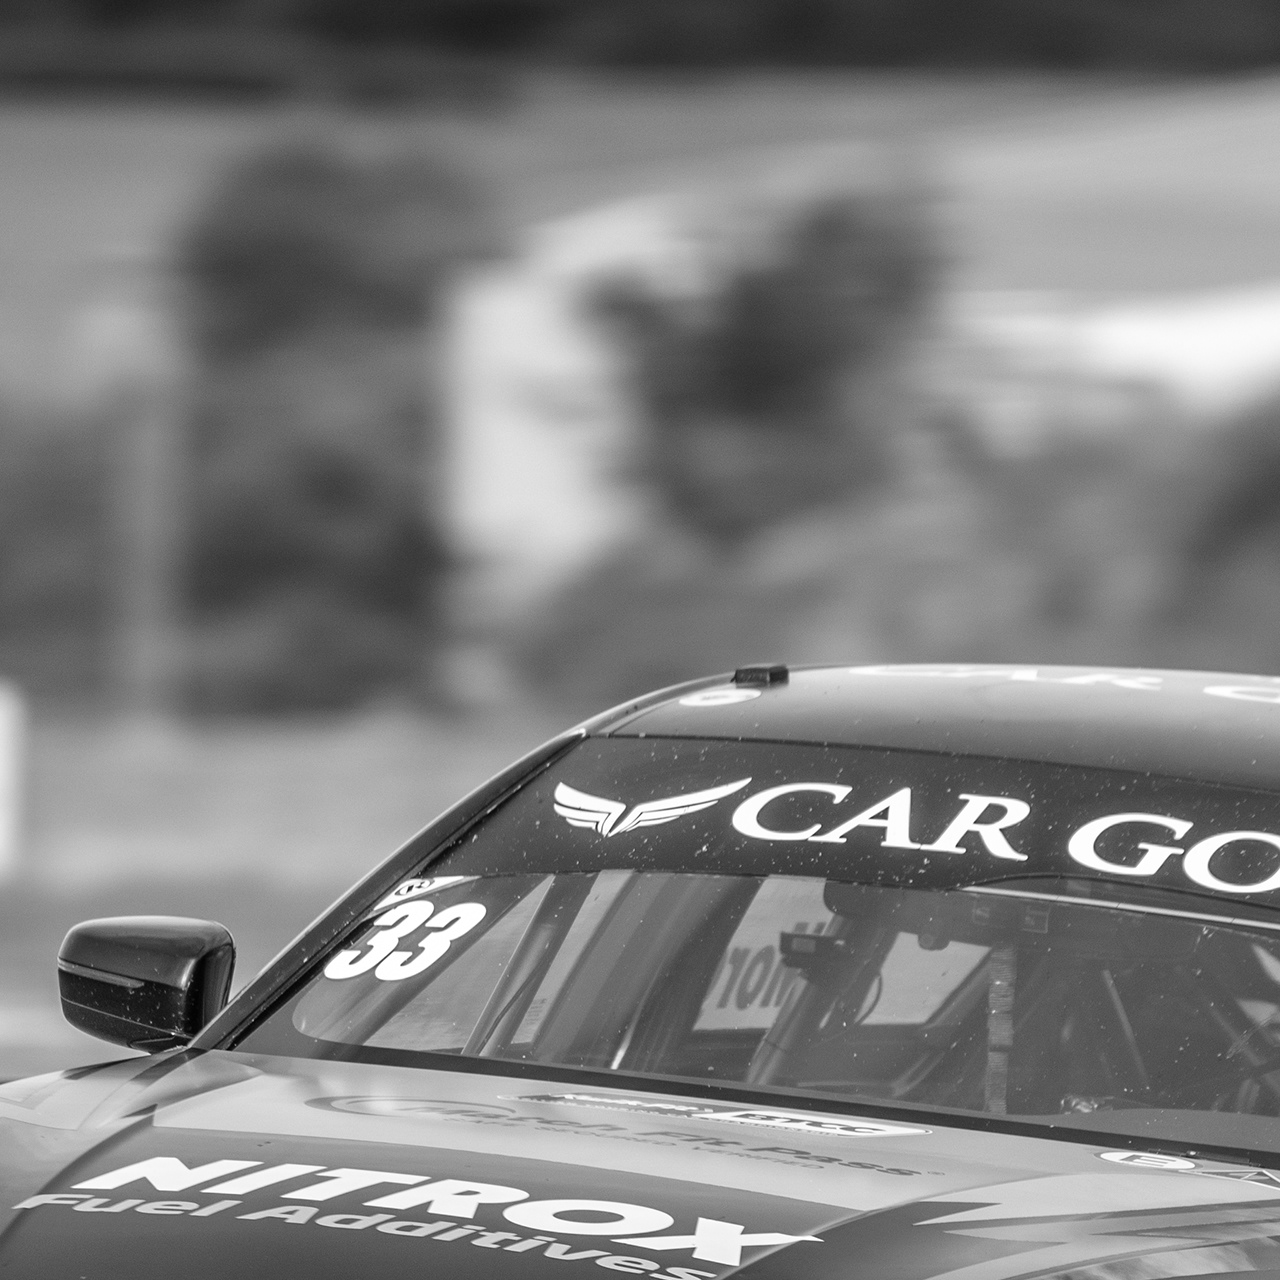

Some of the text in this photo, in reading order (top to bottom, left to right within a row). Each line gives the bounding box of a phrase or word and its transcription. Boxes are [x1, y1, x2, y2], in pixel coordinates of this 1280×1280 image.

[732, 782, 1031, 861] CAR
[324, 900, 487, 981] 33
[746, 1146, 923, 1176] Pass
[18, 1192, 244, 1217] Fuel
[70, 1156, 826, 1266] NITROX
